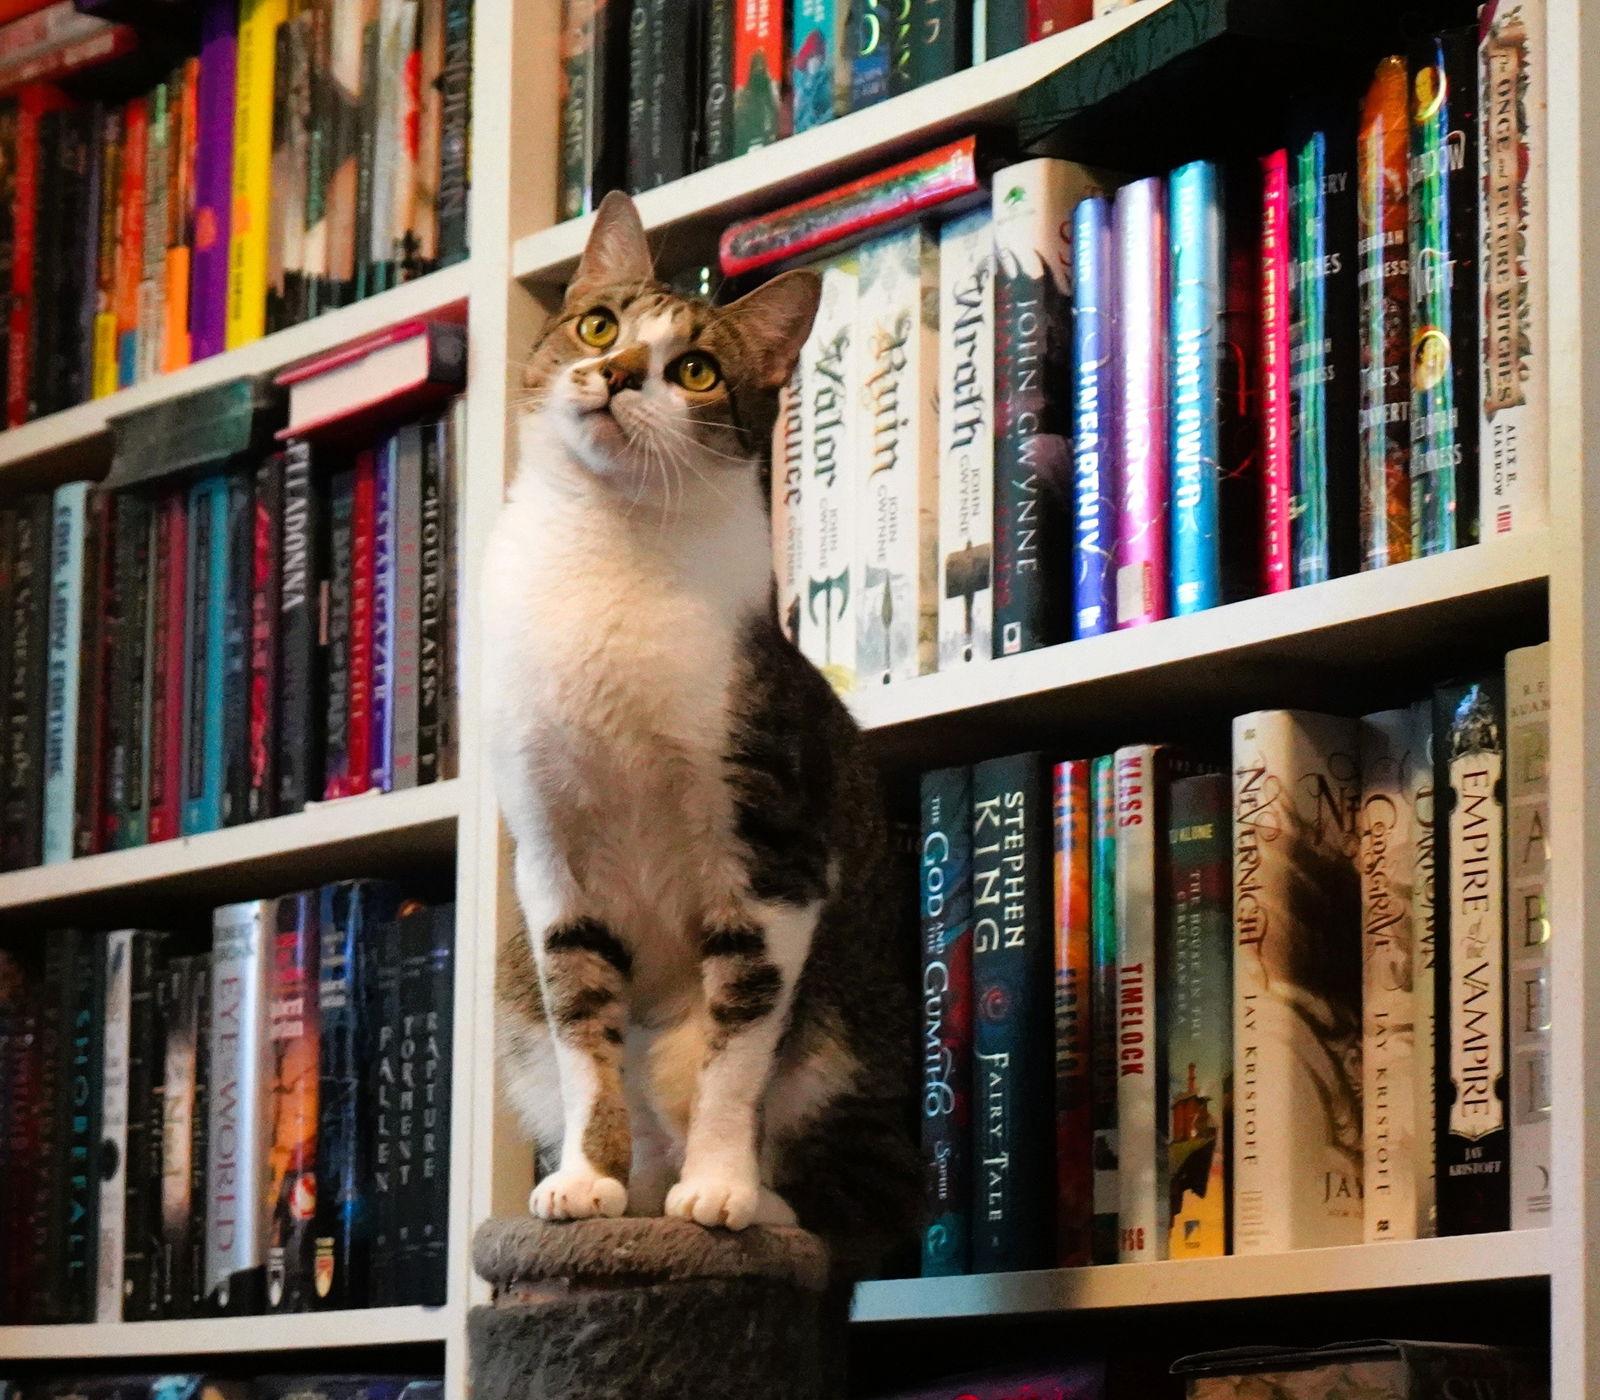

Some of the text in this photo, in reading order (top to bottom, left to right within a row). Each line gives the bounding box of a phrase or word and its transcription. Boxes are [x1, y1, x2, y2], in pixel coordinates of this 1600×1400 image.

[1495, 79, 1513, 152] ONCE
[1495, 186, 1511, 283] FUTURE
[811, 330, 849, 488] Valor
[866, 316, 911, 480] Ruin
[950, 278, 988, 452] Wrath
[1496, 289, 1514, 402] WITCHES
[1012, 300, 1038, 577] JOHN GWYNNE
[1493, 425, 1504, 497] HARROW
[421, 496, 440, 694] HOURGLASS
[1119, 756, 1142, 827] KLASS
[924, 831, 949, 917] GOD
[973, 795, 1000, 953] KING
[1004, 790, 1025, 948] STEPHEN
[1188, 911, 1201, 972] HOUSE
[1461, 769, 1489, 1118] EMPIRE VAMPIRE
[924, 960, 954, 1118] GUMIHO
[1119, 963, 1143, 1077] TIMELOCK
[1243, 994, 1257, 1031] JAY
[1375, 1012, 1388, 1050] JAY
[215, 1082, 241, 1254] WORLD
[976, 1053, 1009, 1221] FAIRY TALE
[1243, 1046, 1258, 1166] KRISTOFF
[1376, 1068, 1391, 1197] KRISTOFF
